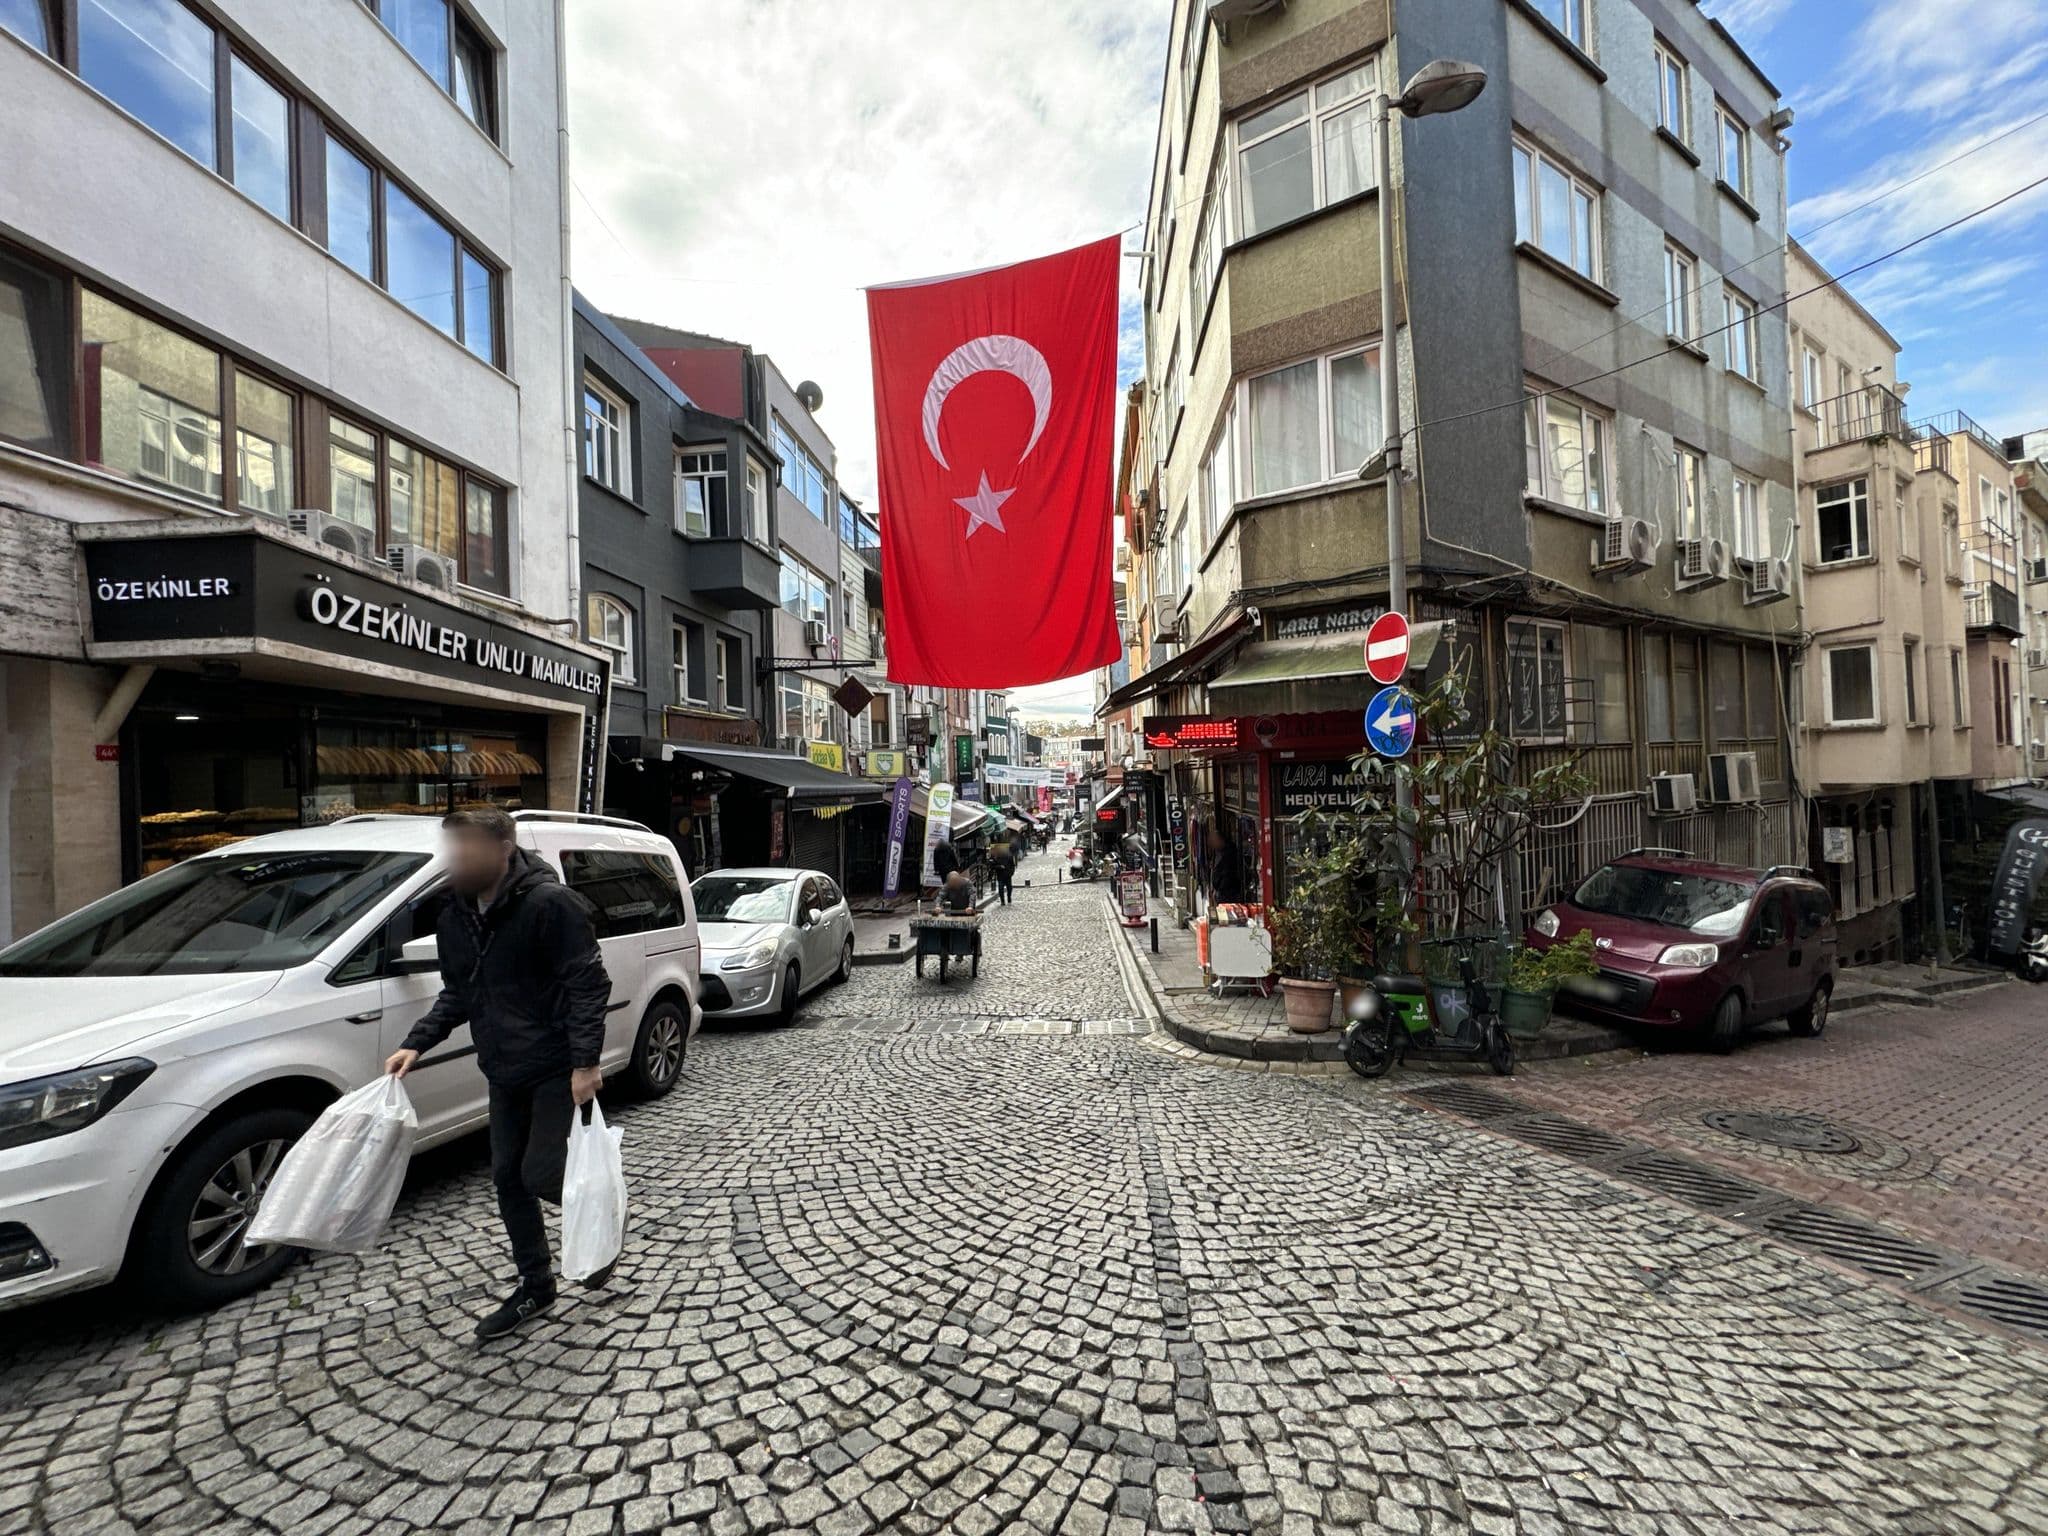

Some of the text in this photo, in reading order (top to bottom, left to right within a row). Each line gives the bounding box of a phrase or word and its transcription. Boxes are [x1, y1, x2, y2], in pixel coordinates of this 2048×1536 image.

[97, 574, 230, 601] ÖZEKİNLER
[311, 573, 468, 662] ÖZEKİNLER
[476, 638, 526, 675] UNLU
[1278, 615, 1319, 634] LARA
[1282, 764, 1327, 788] LARA
[894, 787, 909, 839] SPORTS
